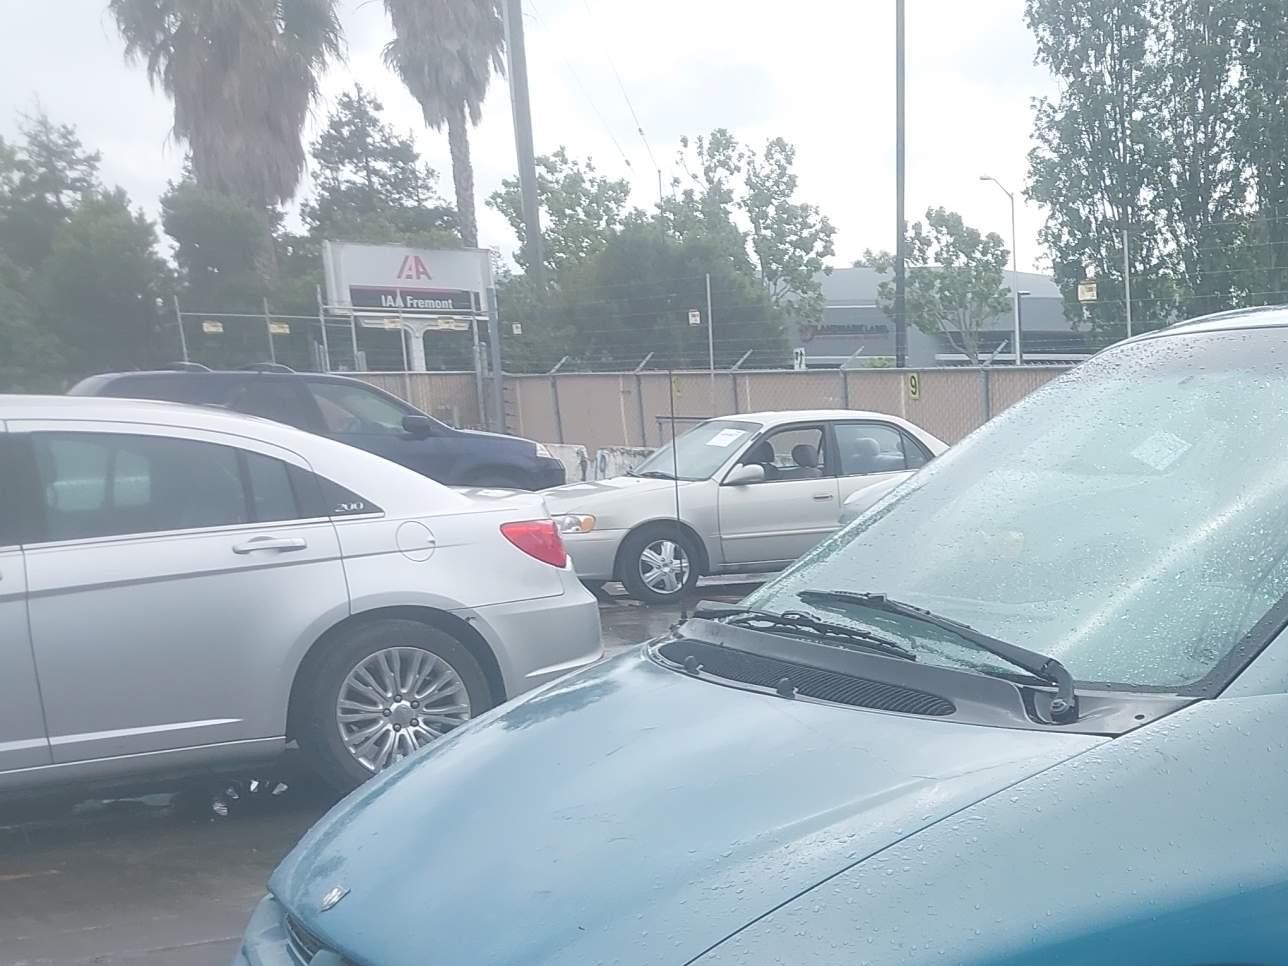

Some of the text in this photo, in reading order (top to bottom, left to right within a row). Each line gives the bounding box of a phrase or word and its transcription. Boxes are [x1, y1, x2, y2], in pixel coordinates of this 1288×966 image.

[381, 295, 453, 309] IAA Fremont
[910, 375, 918, 395] 9
